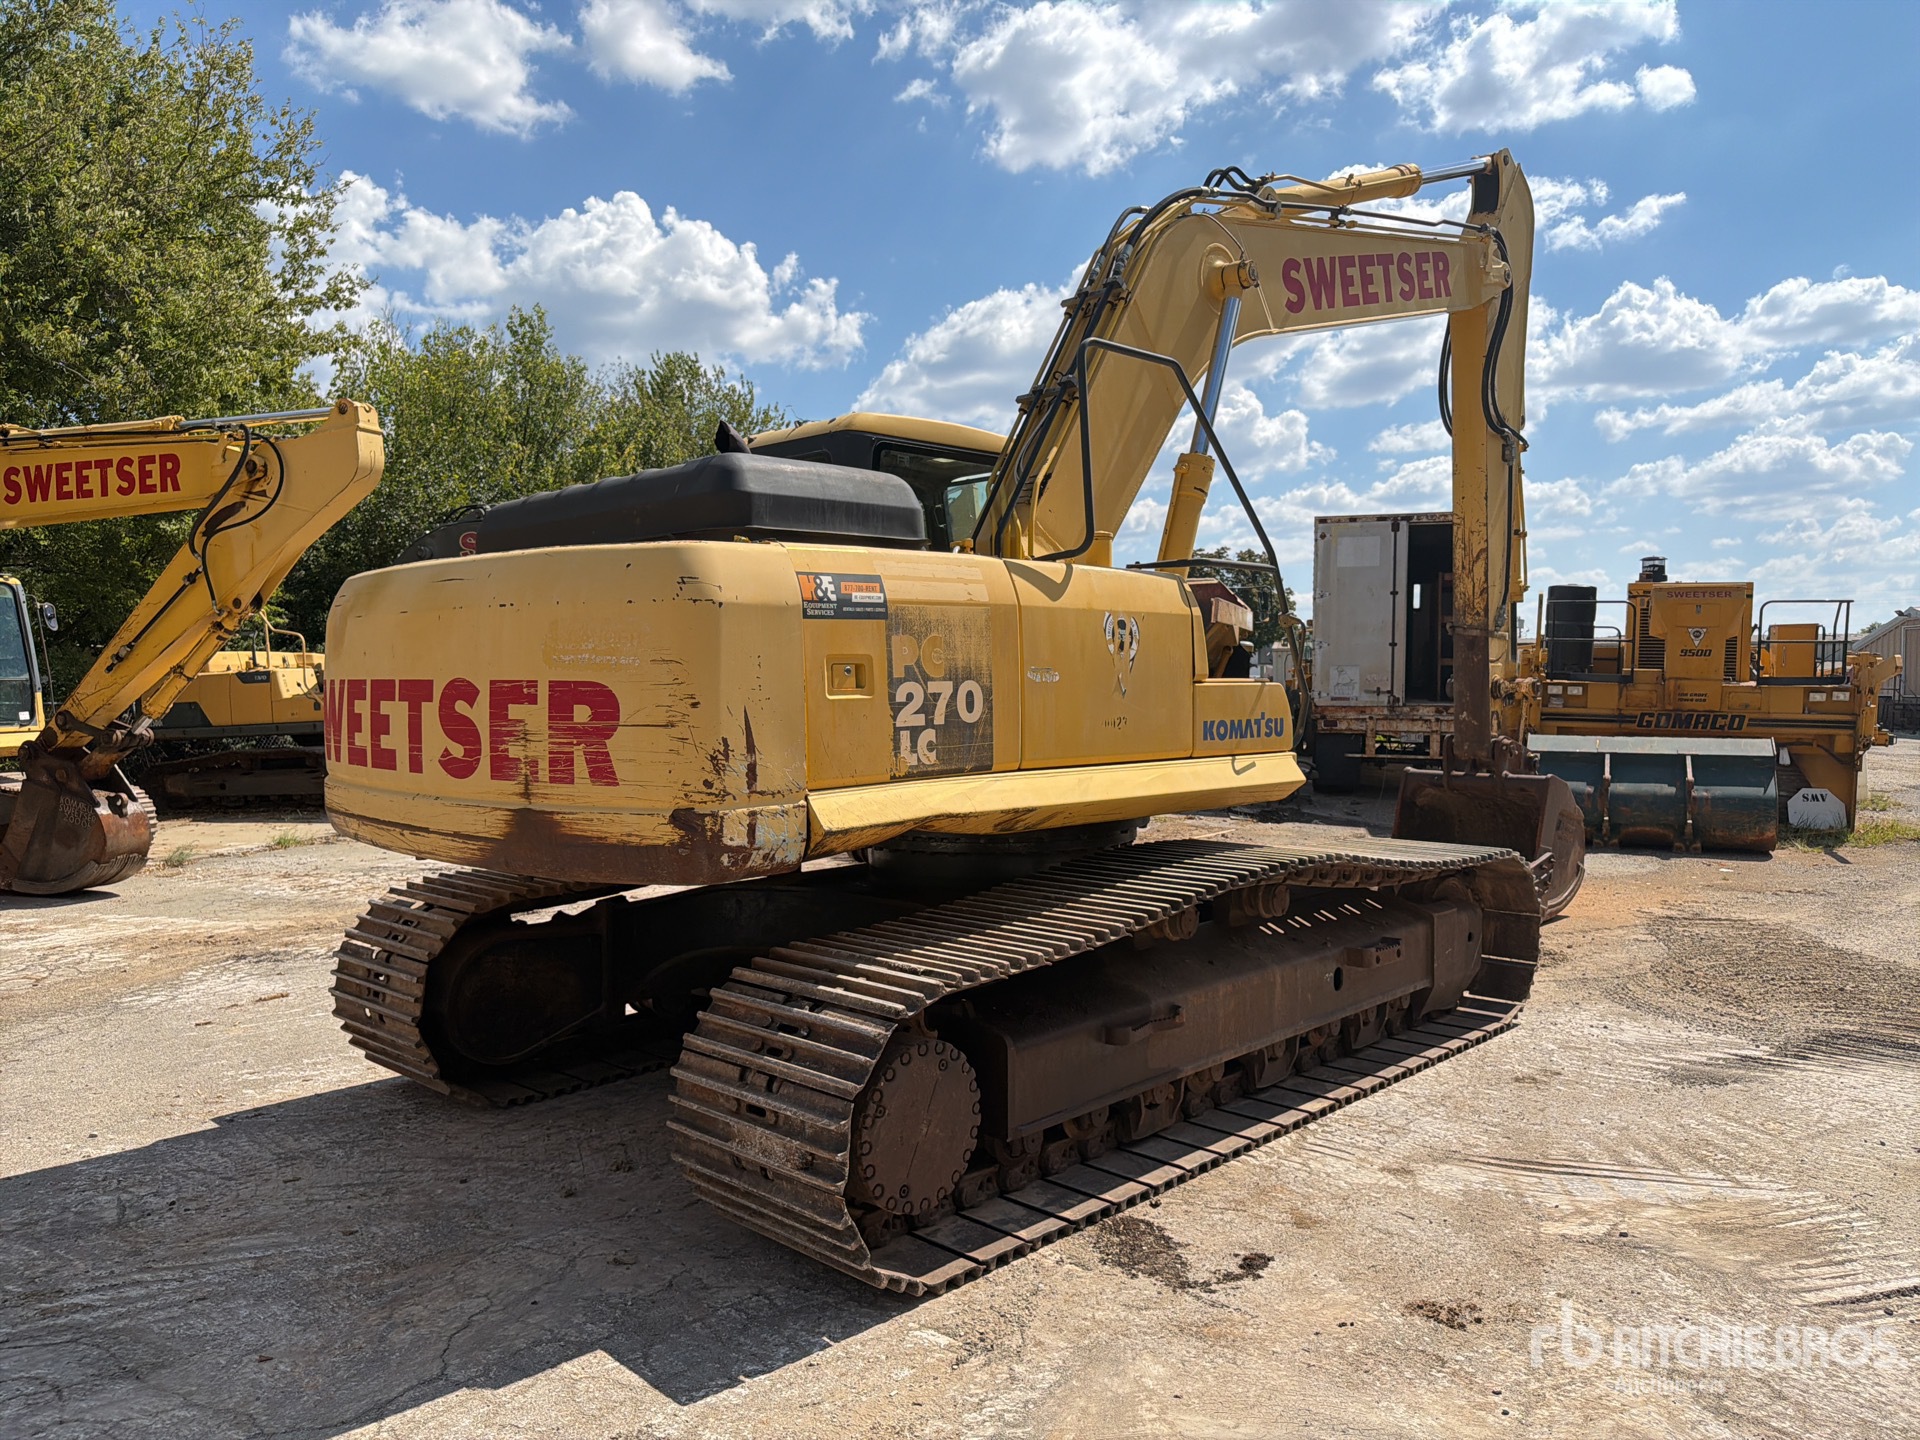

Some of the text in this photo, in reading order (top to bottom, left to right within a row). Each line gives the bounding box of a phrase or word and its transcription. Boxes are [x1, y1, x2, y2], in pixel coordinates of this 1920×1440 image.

[1281, 251, 1452, 314] SWEETSER
[3, 453, 181, 505] SWEETSER
[1666, 591, 1732, 599] SWEETSER
[891, 634, 945, 678] PC
[1680, 649, 1712, 657] 9500
[895, 680, 983, 727] 270
[1637, 712, 1746, 731] GOMACO
[324, 677, 620, 787] WEETSER
[1203, 711, 1284, 741] KOMATSU
[900, 728, 938, 766] LC
